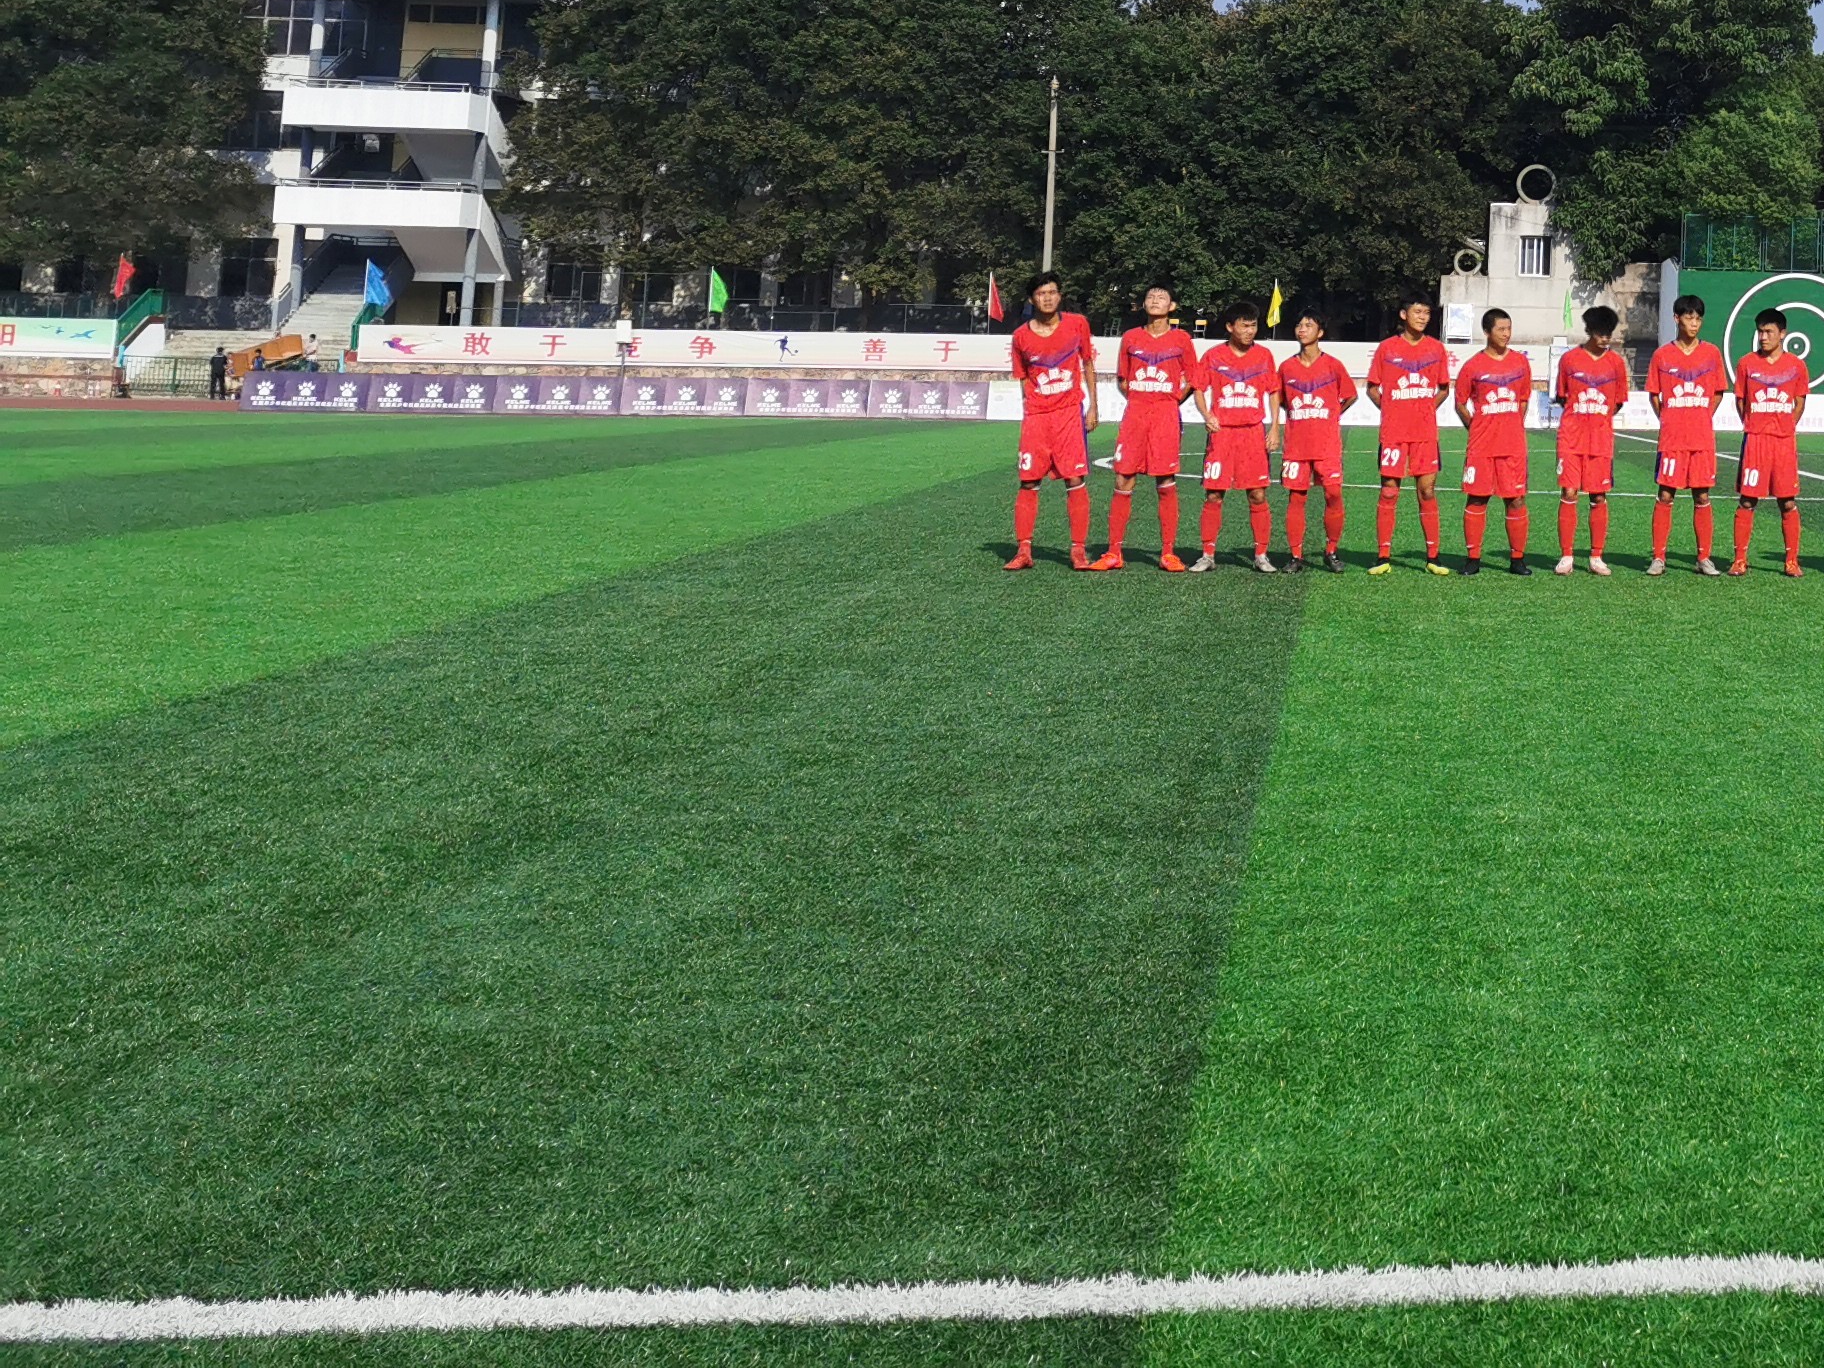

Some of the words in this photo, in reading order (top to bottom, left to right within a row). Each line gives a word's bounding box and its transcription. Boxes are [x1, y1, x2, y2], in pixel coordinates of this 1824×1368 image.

[1381, 447, 1400, 467] 29
[1203, 461, 1221, 480] 30
[1281, 461, 1300, 480] 28
[1662, 458, 1676, 477] 11
[1743, 468, 1759, 488] 10
